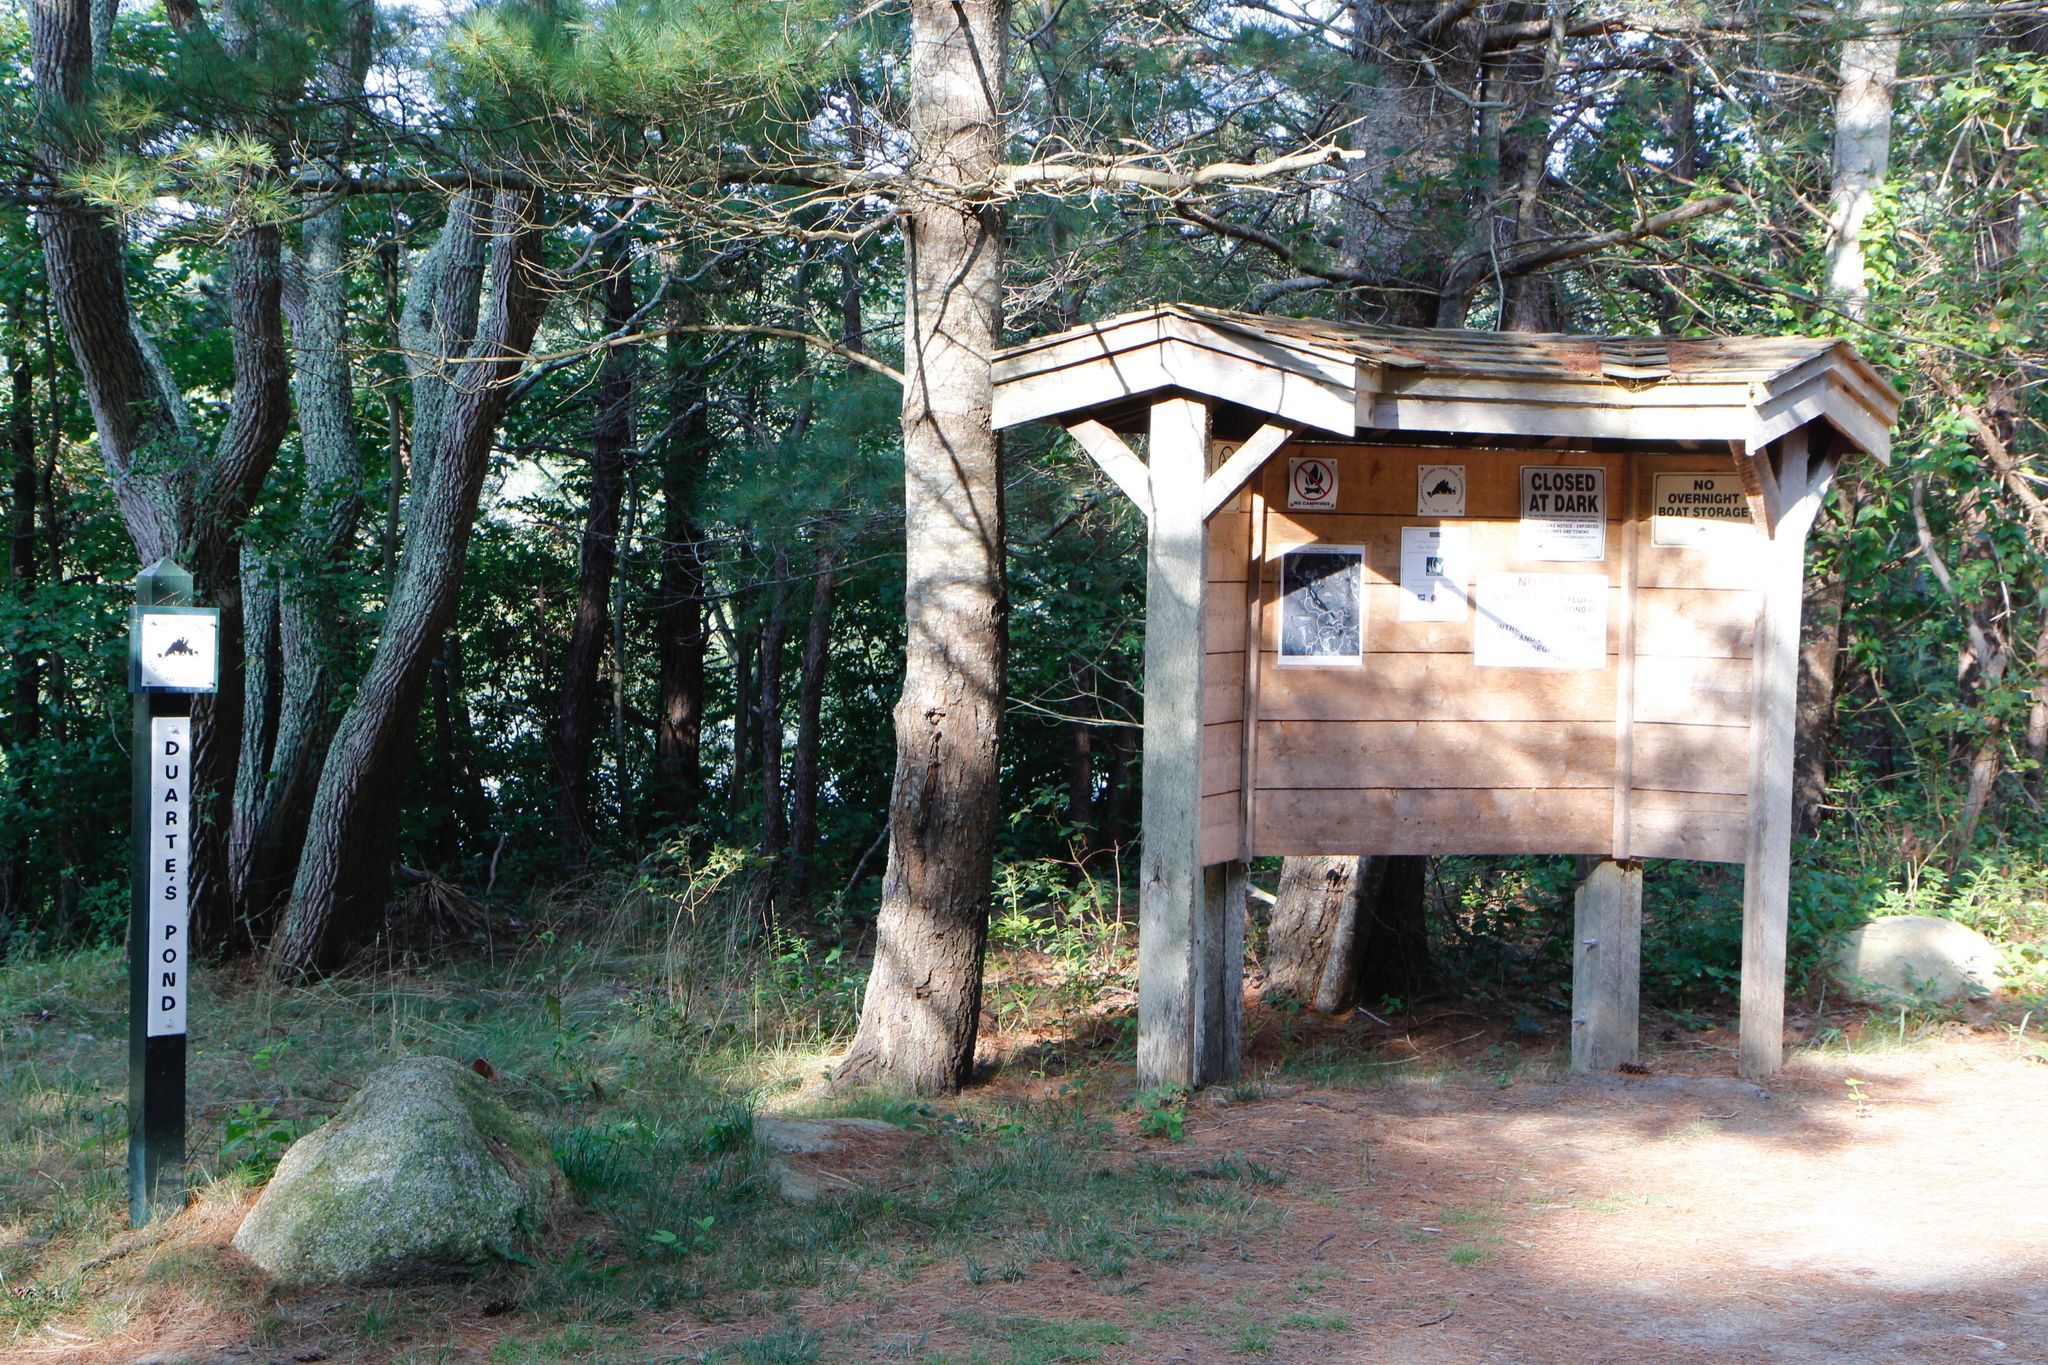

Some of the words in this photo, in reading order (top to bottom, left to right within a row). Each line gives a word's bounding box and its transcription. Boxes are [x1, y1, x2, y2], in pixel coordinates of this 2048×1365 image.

[1531, 472, 1596, 492] CLOSED
[1693, 480, 1714, 491] NO
[1529, 494, 1550, 512] AT
[1554, 494, 1599, 513] DARK
[1668, 493, 1740, 504] OVERNIGHT
[1658, 506, 1689, 517] BOAT
[1692, 507, 1749, 518] STORAGE
[164, 741, 180, 900] DUARTE'S
[161, 924, 178, 1012] POND
